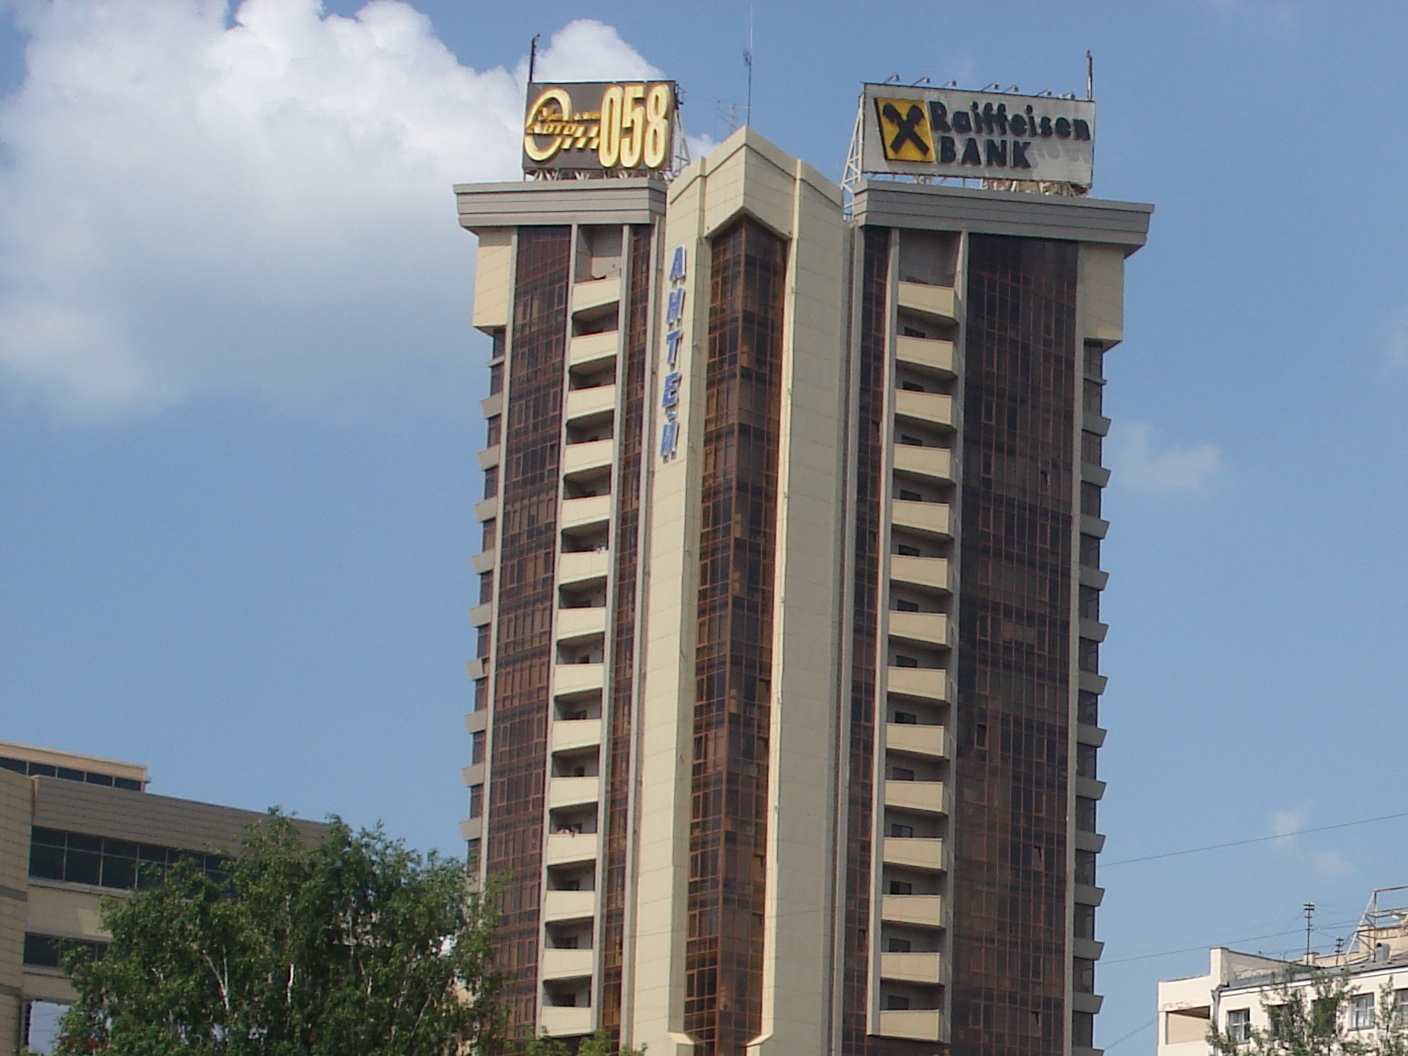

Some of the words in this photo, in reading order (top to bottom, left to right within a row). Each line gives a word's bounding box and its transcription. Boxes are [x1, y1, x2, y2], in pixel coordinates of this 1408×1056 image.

[599, 84, 671, 168] 058
[928, 100, 1091, 142] Raiffeisen
[938, 135, 1032, 169] BANK
